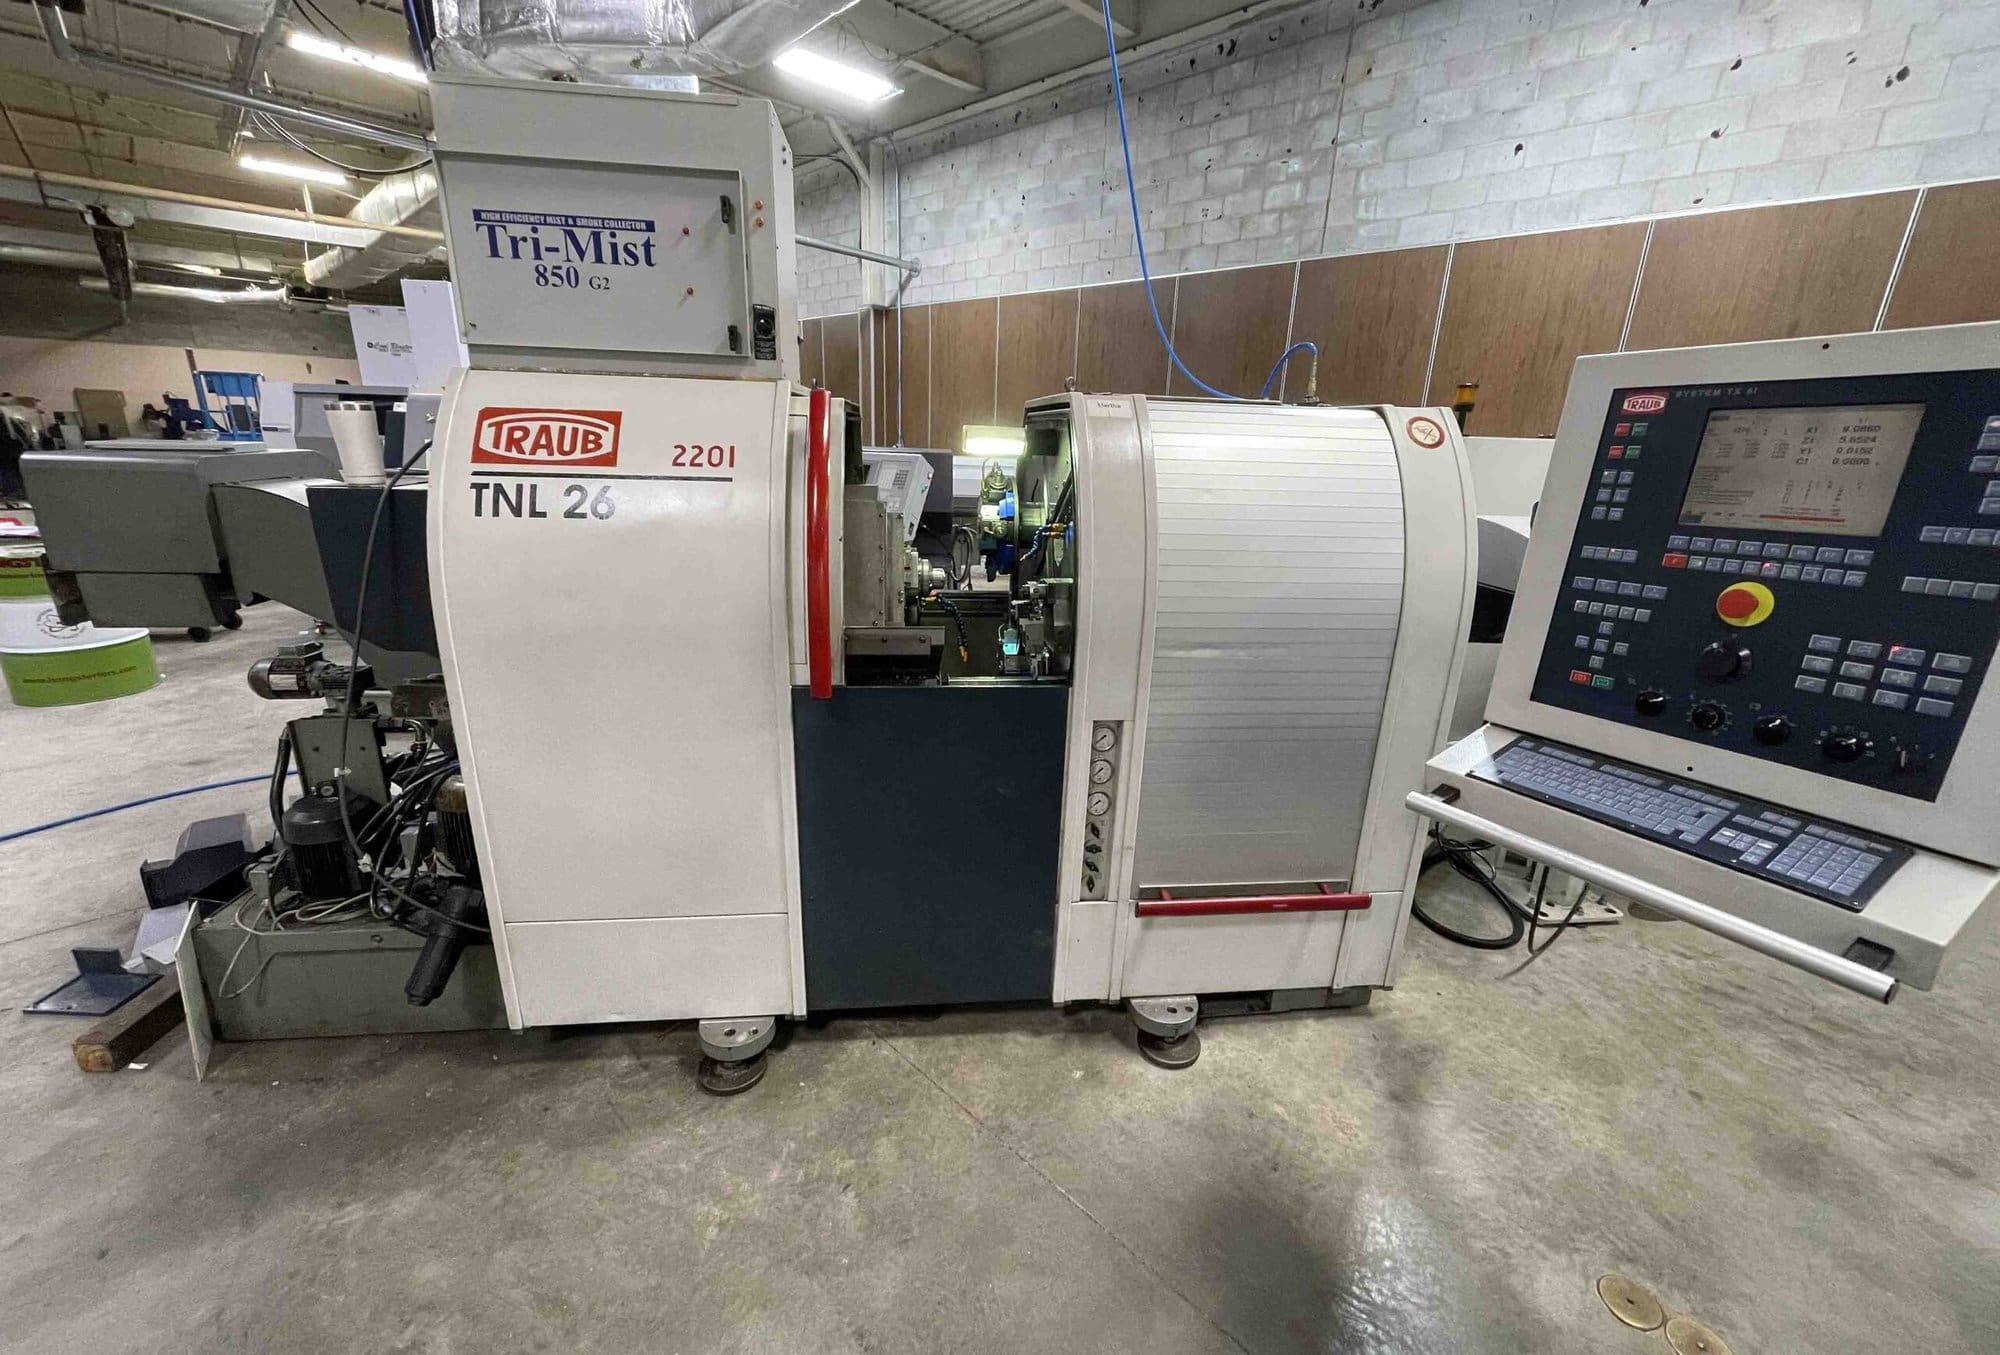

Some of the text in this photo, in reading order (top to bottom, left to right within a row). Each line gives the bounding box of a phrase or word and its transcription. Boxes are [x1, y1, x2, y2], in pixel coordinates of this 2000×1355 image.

[481, 211, 500, 221] HIGH
[502, 213, 545, 224] EFFICIENCY
[546, 216, 566, 226] MIST
[576, 217, 603, 228] SMOKE
[604, 219, 647, 230] COLLECTOR
[475, 222, 657, 267] Tri-Mist
[534, 263, 611, 290] 850 G2
[1624, 396, 1663, 411] TRAUB
[1675, 388, 1722, 398] SYSTEM
[487, 416, 609, 457] TRAUB
[671, 444, 736, 469] 2201
[469, 482, 616, 520] TNL 26
